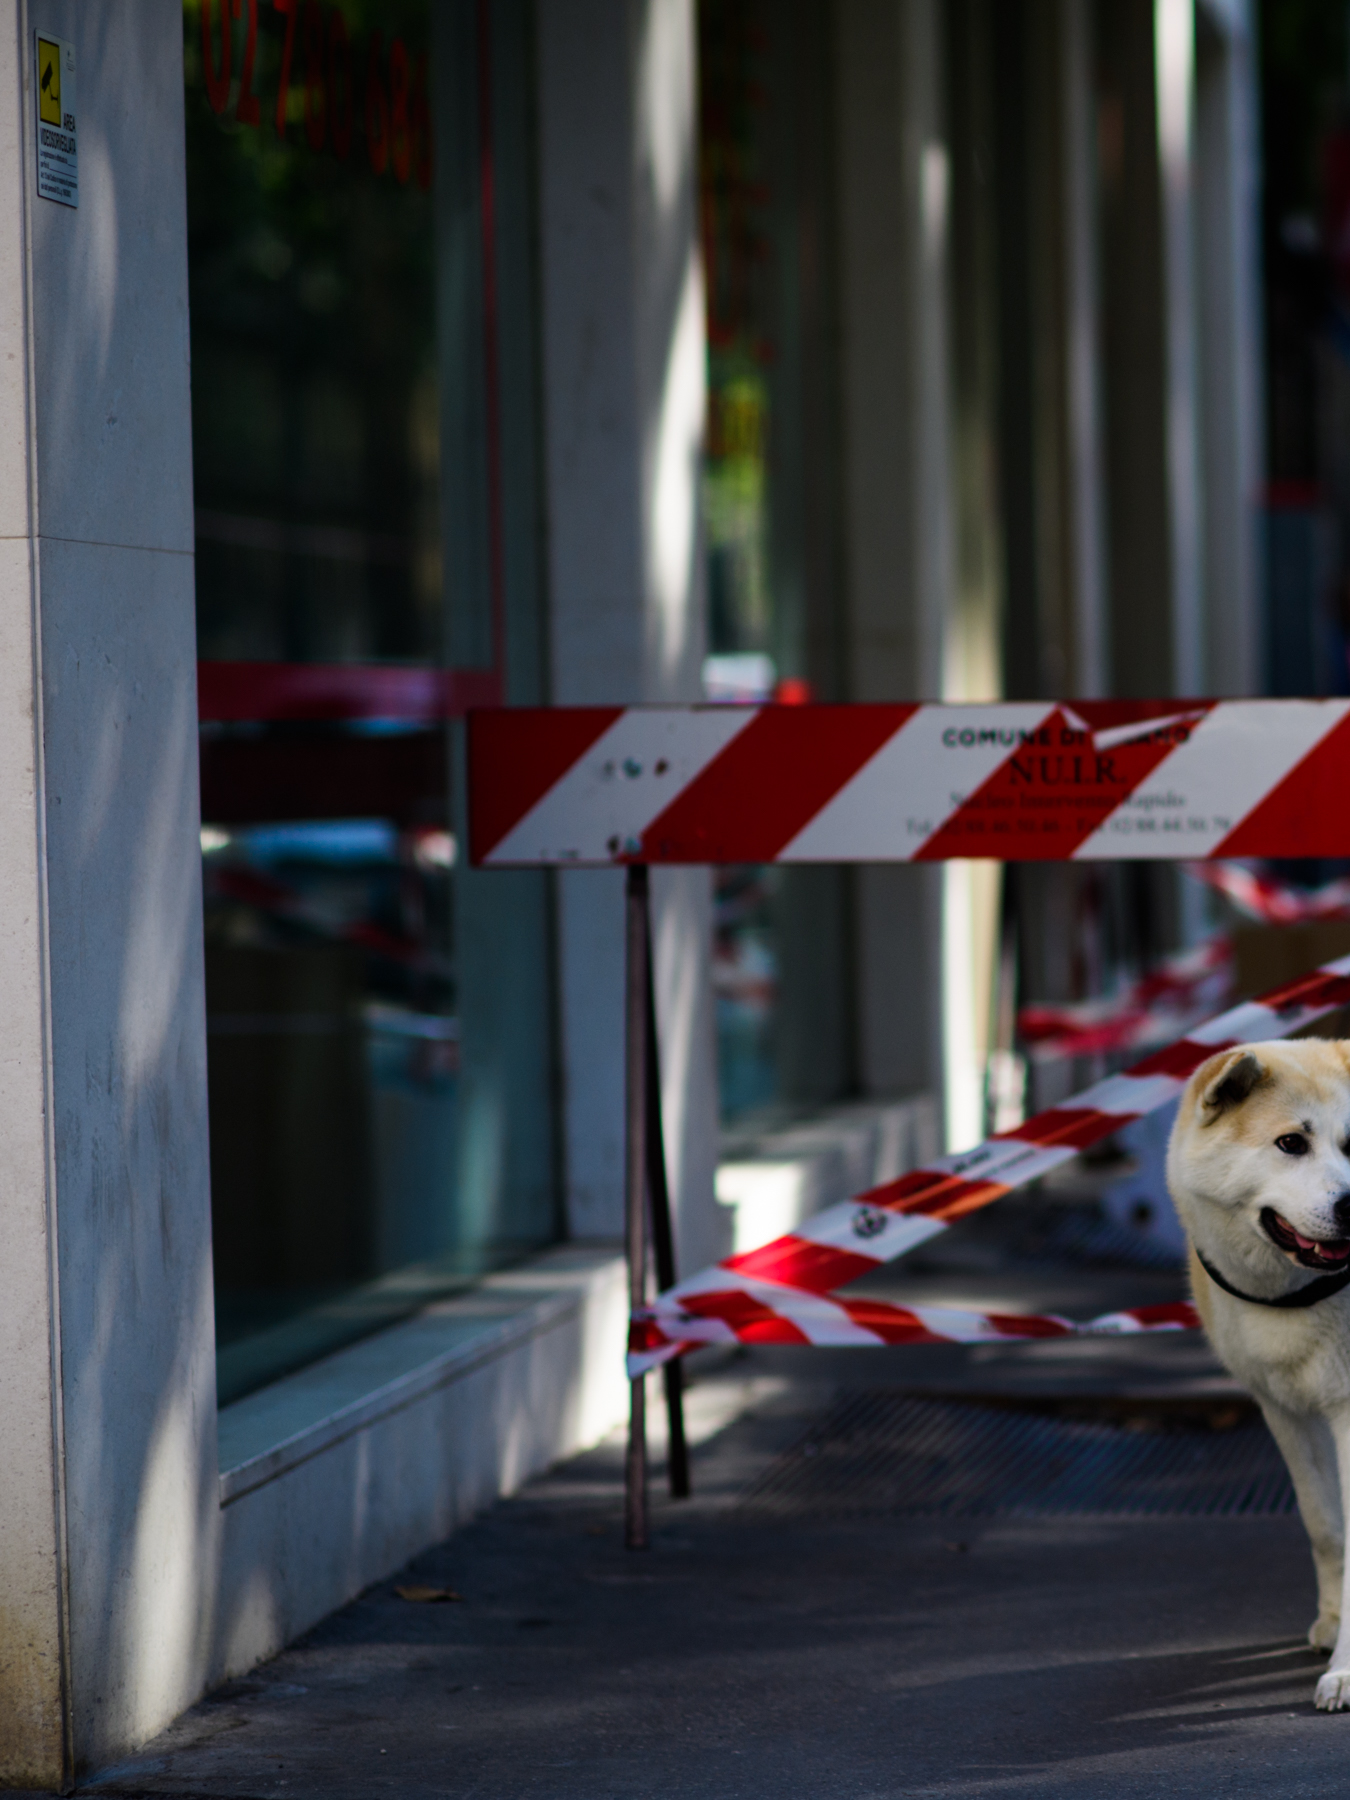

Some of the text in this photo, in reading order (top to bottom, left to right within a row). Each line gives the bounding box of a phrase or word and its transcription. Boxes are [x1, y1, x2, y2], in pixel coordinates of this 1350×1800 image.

[942, 727, 1049, 747] COMUNE
[1060, 727, 1084, 745] DI
[1122, 789, 1186, 811] Rapido
